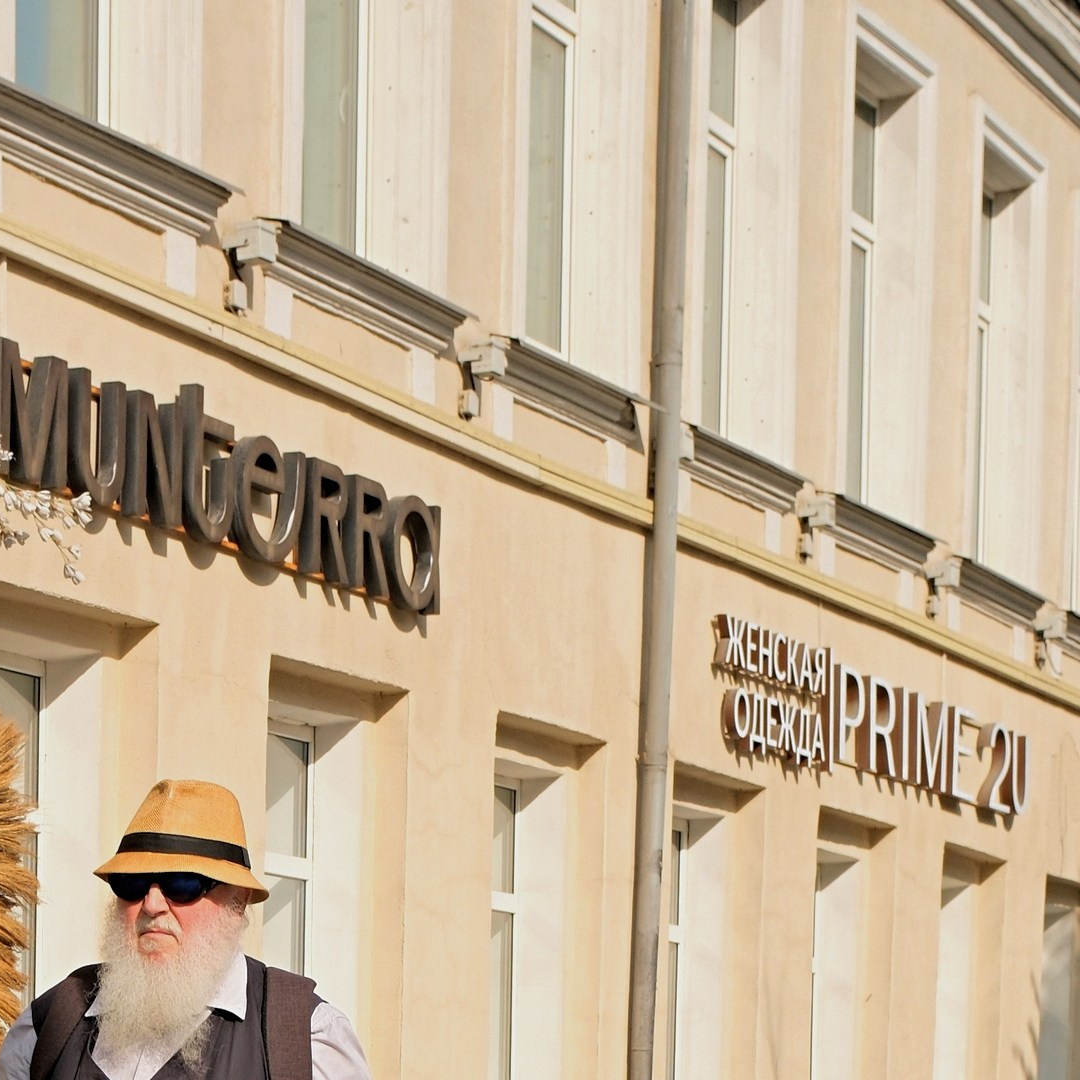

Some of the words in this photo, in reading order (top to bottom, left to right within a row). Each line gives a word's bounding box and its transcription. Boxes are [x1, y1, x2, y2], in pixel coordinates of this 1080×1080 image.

[720, 614, 827, 697] ЖЕНСКАЯ
[728, 687, 826, 768] ОДЕЖДА
[835, 664, 978, 803] PRIME
[978, 722, 1029, 816] 2U
